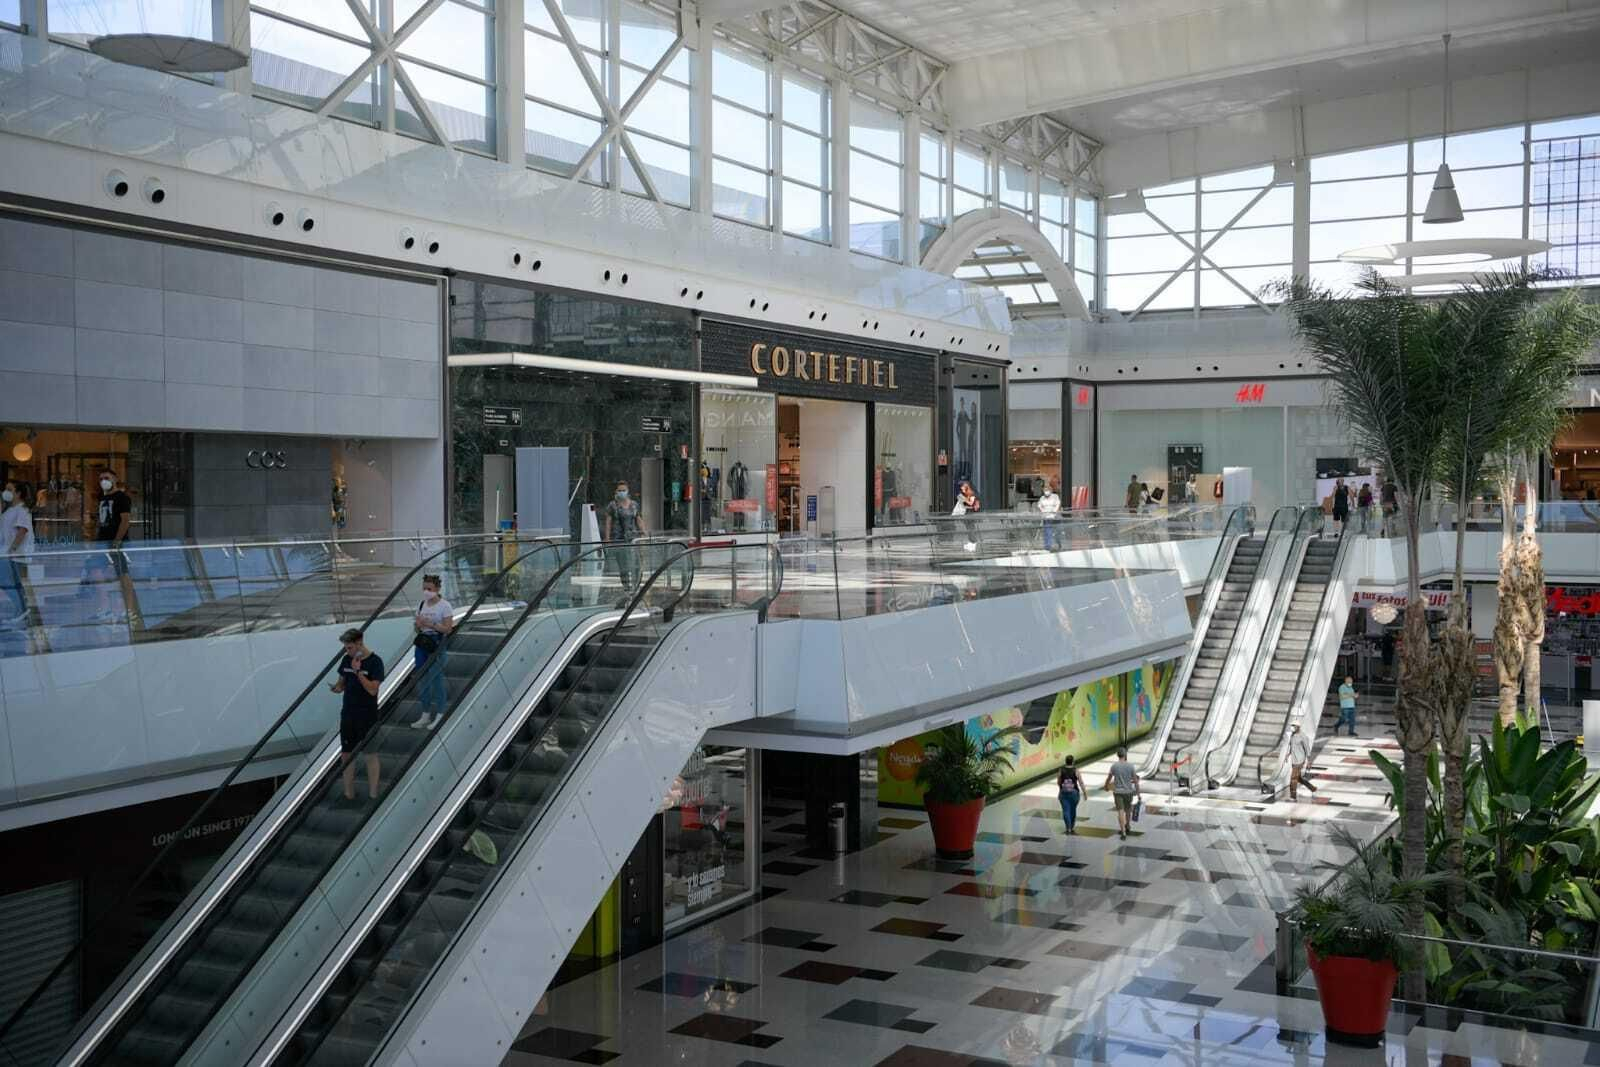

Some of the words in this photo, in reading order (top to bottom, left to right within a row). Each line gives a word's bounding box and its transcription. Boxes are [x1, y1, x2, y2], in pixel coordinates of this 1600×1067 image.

[750, 343, 898, 389] CORTEFIEL
[246, 450, 287, 469] COS
[152, 826, 200, 847] LONON
[202, 819, 231, 834] SINCE
[233, 815, 255, 828] 197
